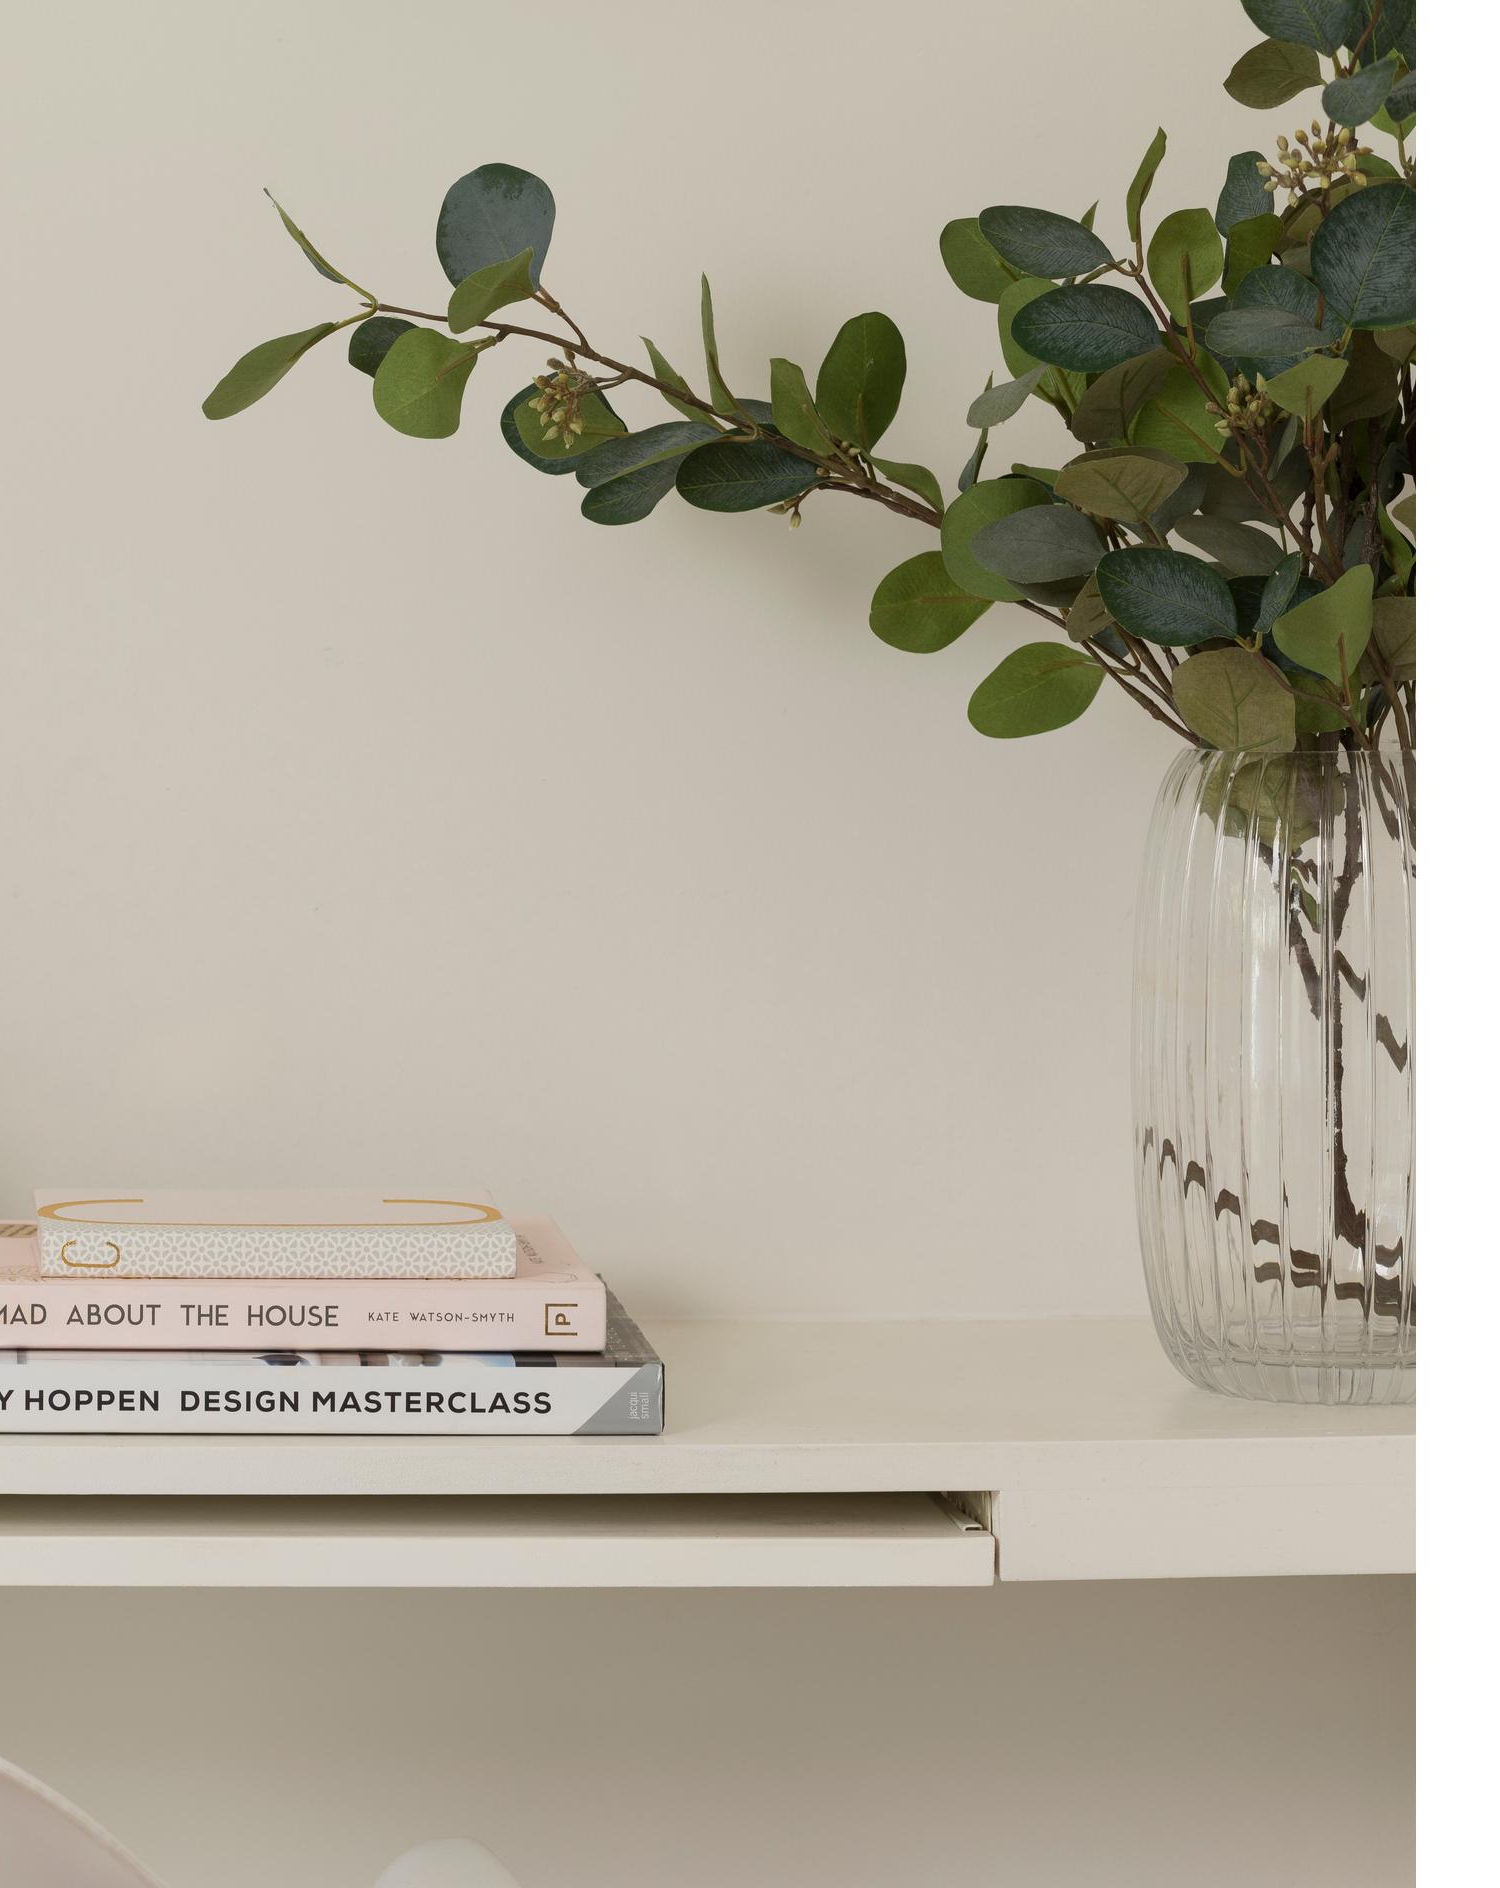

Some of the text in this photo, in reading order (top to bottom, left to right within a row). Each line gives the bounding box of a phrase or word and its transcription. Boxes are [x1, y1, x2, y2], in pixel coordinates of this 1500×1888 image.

[66, 1303, 162, 1326] ABOUT
[180, 1304, 229, 1327] THE
[247, 1304, 339, 1327] HOUSE
[367, 1311, 515, 1323] KATE WATSON-SMYTH
[25, 1389, 159, 1412] HOPPEN
[180, 1390, 299, 1413] DESIGN
[312, 1390, 552, 1415] MASTERCLASS
[627, 1391, 639, 1420] jacqui
[639, 1392, 649, 1420] small
